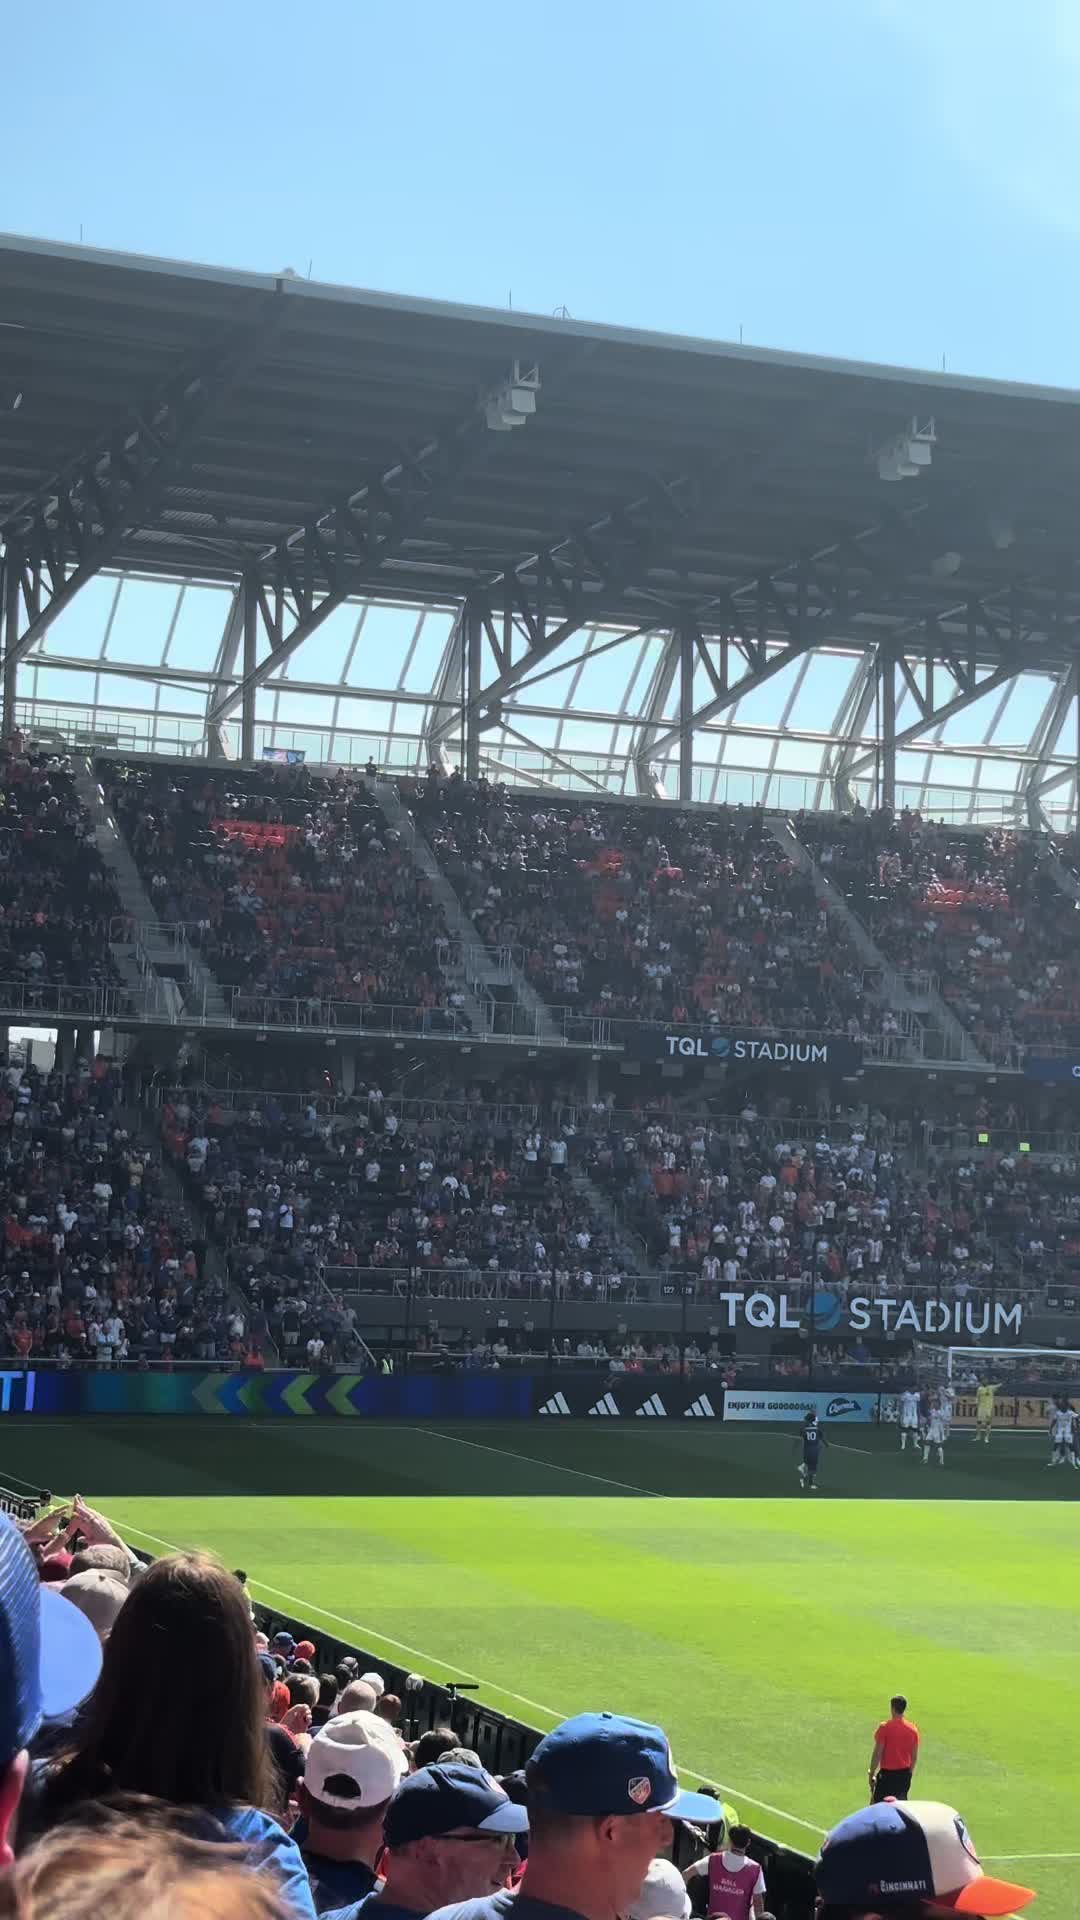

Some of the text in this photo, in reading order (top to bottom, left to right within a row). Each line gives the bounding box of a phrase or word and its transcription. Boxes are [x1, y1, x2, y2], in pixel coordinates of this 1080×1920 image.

[666, 1036, 827, 1062] TQL STADIUM
[720, 1292, 1022, 1335] TQL STADIUM
[728, 1401, 751, 1411] ENJOY
[752, 1401, 766, 1410] THE
[806, 1431, 816, 1440] 10
[880, 1879, 926, 1892] CINCINNATI
